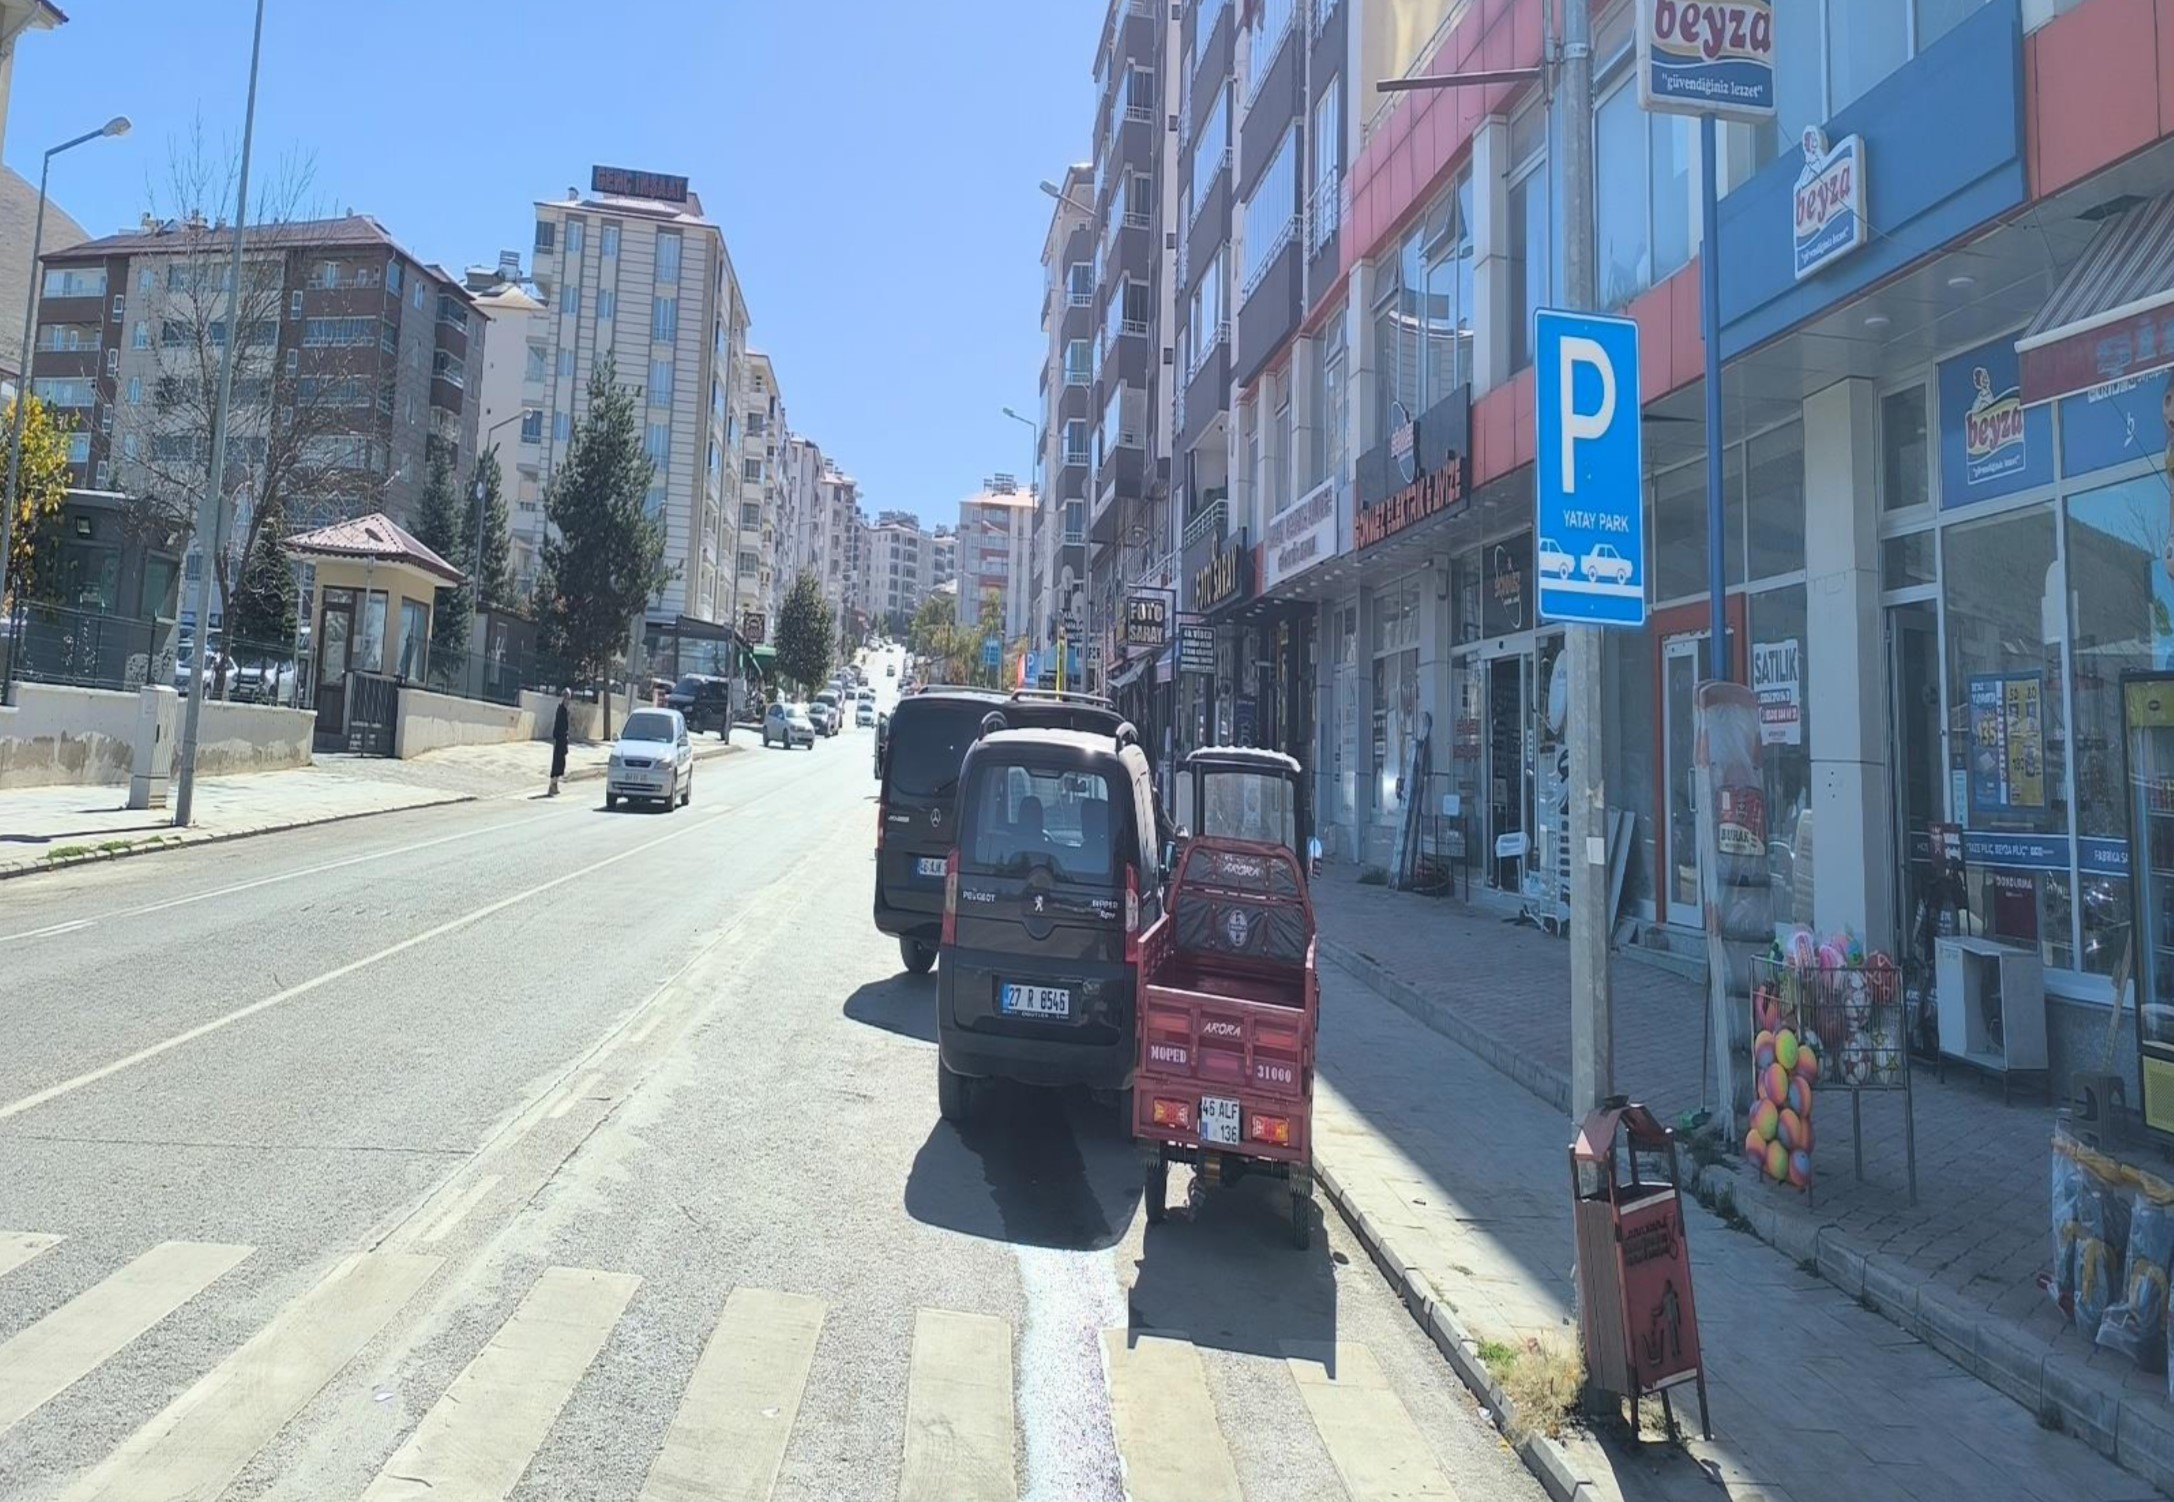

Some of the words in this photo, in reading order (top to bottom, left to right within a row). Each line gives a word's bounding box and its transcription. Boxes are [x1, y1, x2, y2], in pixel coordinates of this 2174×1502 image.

[1655, 0, 1771, 58] beyza
[1795, 165, 1851, 228] beyza
[1560, 335, 1616, 494] P
[1966, 406, 2023, 451] beyza
[1563, 509, 1597, 530] YATAY
[1599, 512, 1629, 533] PARK
[1130, 602, 1163, 622] FOTO
[1130, 624, 1163, 643] SARAY
[1755, 648, 1798, 685] SATILIK
[963, 890, 996, 902] PEUGEOT
[1009, 987, 1021, 1007] 27
[1028, 989, 1034, 1009] R
[1040, 990, 1065, 1011] 8546
[1203, 1022, 1241, 1037] ARORA
[1151, 1045, 1187, 1063] MOPED
[1257, 1065, 1292, 1083] 31000
[1202, 1099, 1215, 1116] 46
[1218, 1101, 1238, 1119] ALF
[1220, 1124, 1237, 1143] 136
